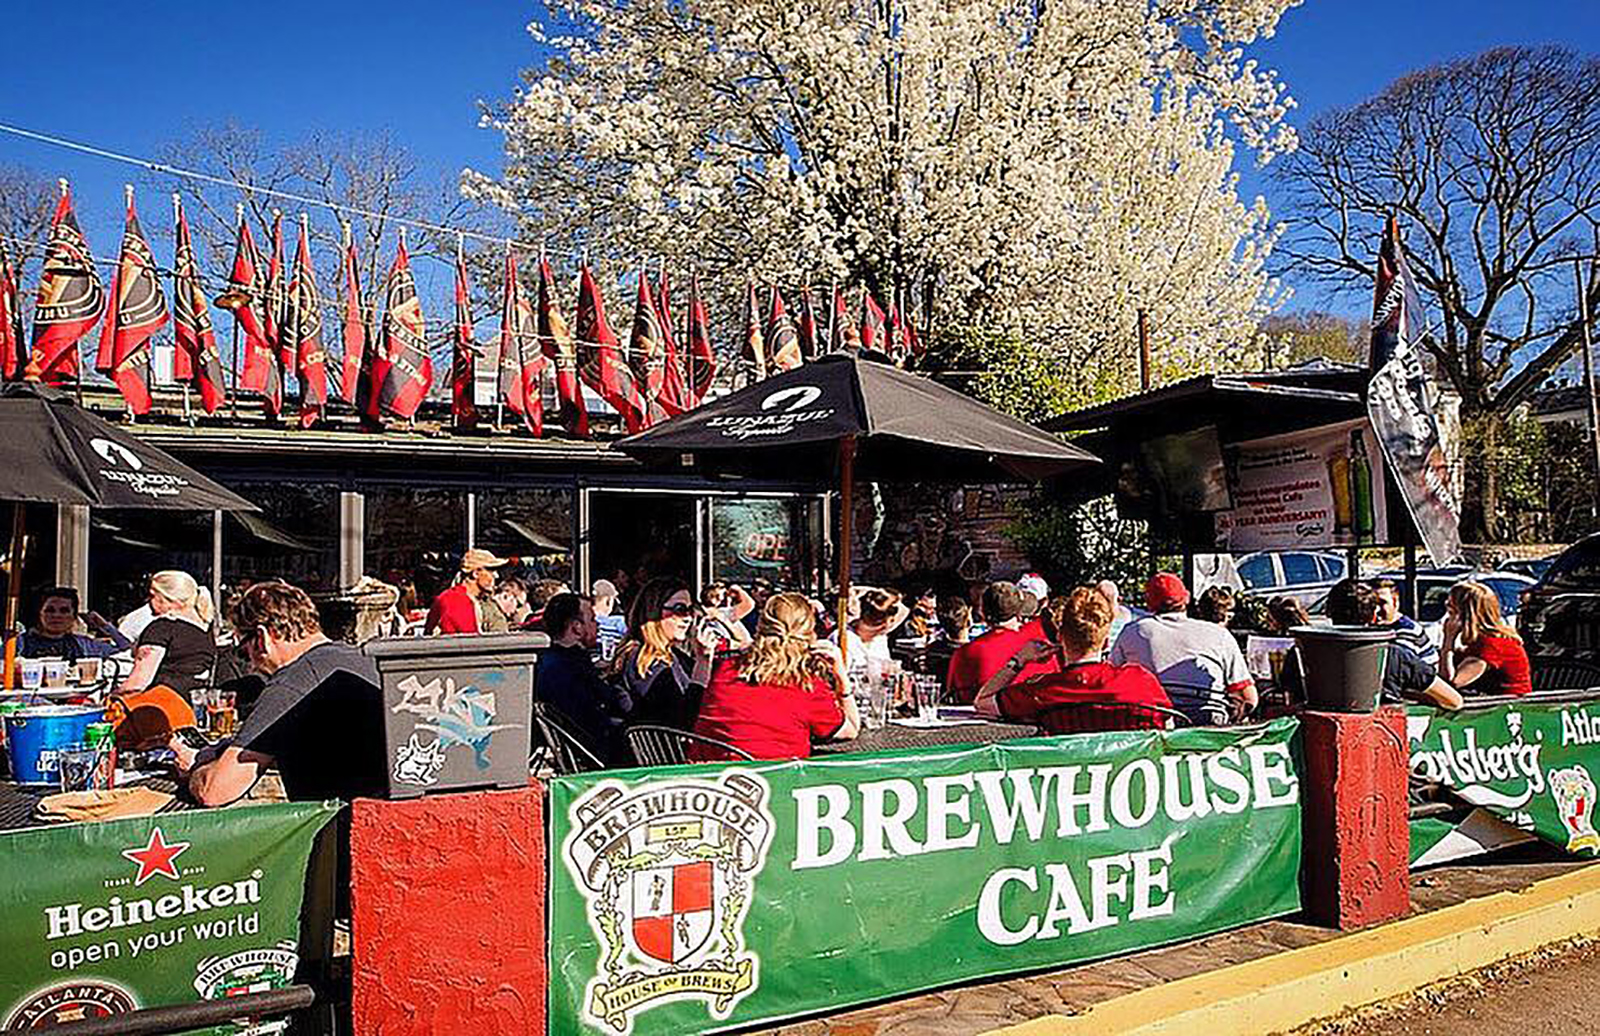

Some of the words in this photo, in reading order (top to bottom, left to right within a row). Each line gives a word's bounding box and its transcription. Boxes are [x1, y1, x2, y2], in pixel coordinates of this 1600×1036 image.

[583, 792, 760, 853] BREWHOUSE
[791, 742, 1300, 871] BREWHOUSE
[44, 877, 261, 939] Heineken
[50, 939, 120, 970] open
[128, 926, 187, 958] your
[193, 911, 259, 940] world
[23, 987, 115, 1020] ATLANTA
[609, 980, 662, 1009] HOUSE
[681, 974, 734, 990] BREWS
